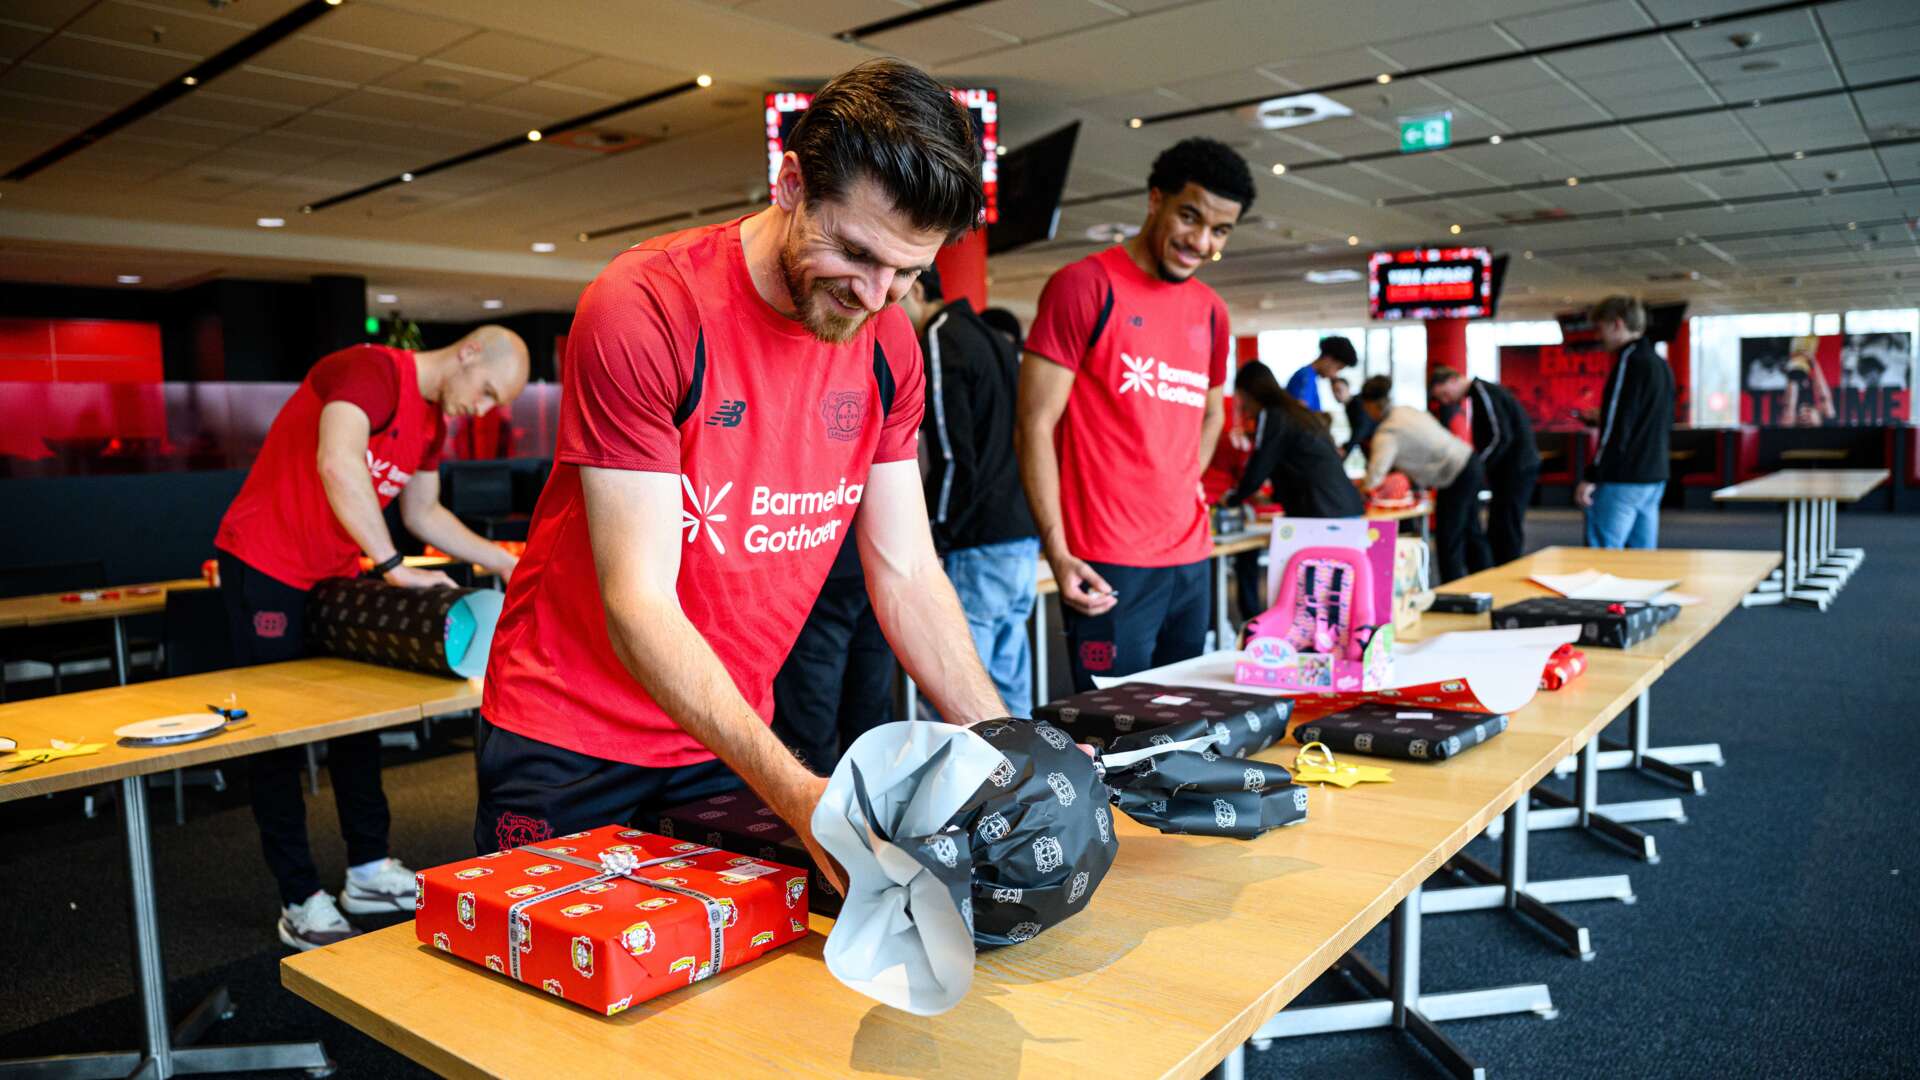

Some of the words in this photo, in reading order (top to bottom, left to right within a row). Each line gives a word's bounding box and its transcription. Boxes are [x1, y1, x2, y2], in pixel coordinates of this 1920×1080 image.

[751, 477, 864, 515] Barmeia
[744, 519, 842, 553] Gothaer
[713, 927, 721, 974] EVERKUSEN
